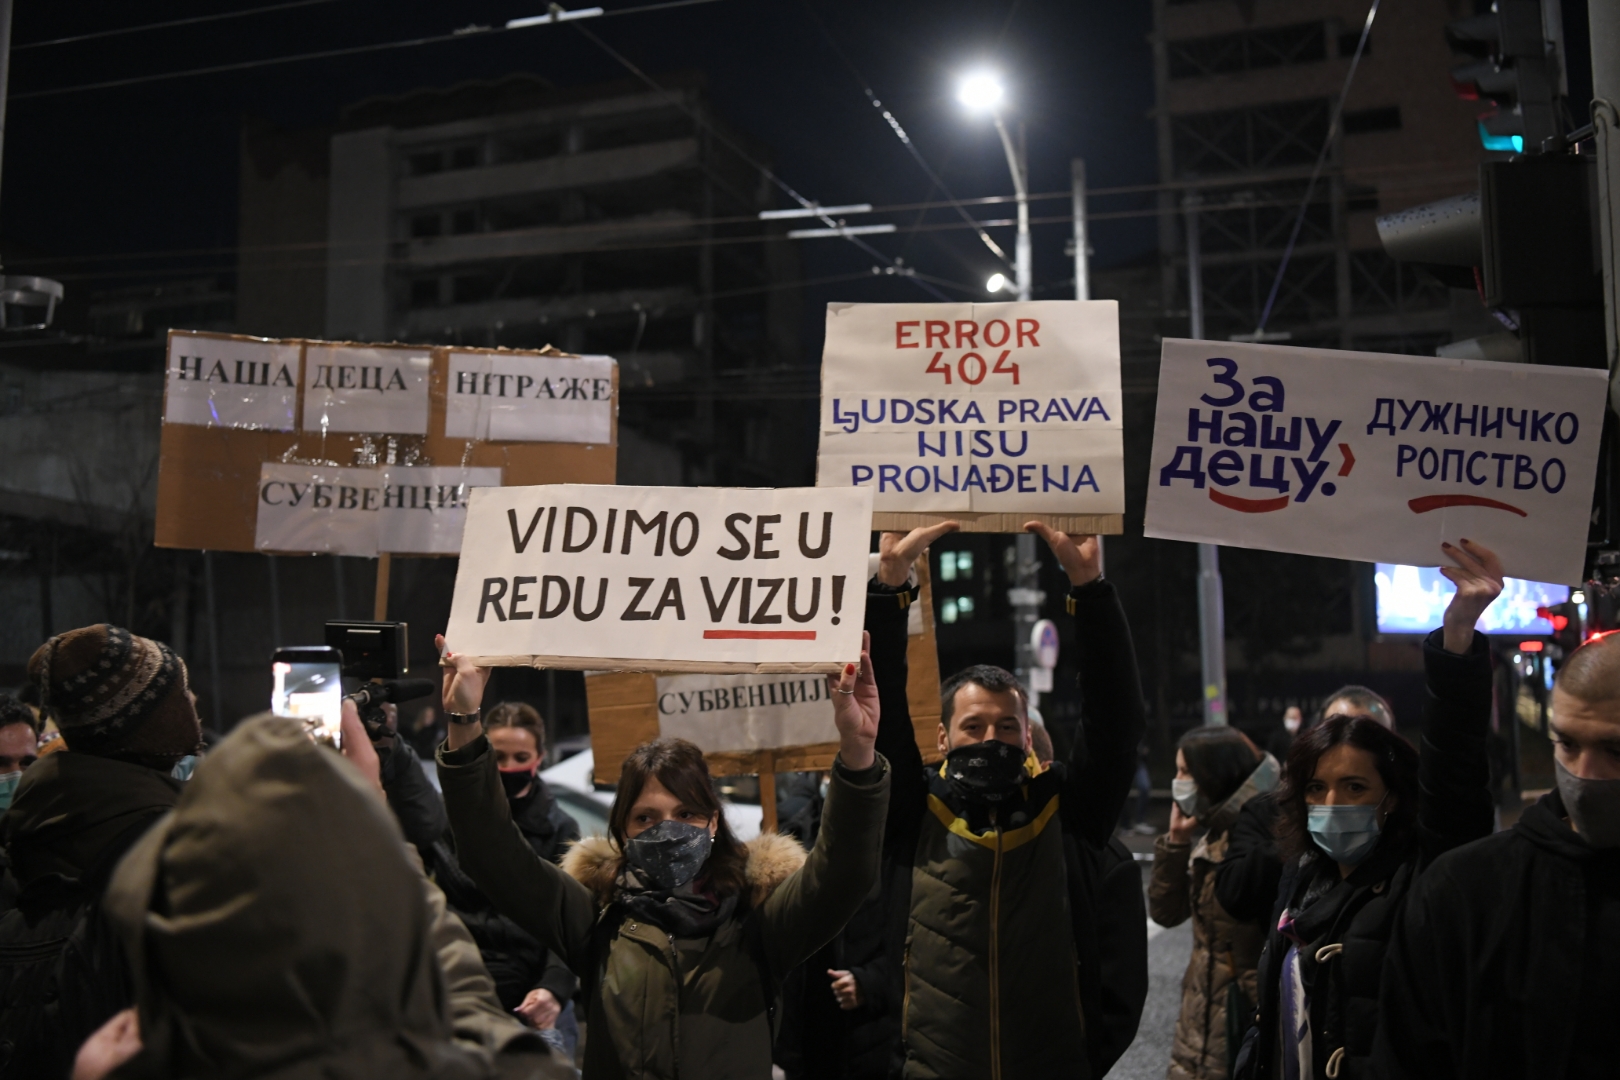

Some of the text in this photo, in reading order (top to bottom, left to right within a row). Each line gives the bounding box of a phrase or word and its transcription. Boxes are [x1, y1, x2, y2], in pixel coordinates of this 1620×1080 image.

[896, 318, 1040, 349] ERROR
[179, 356, 295, 387] НАША
[312, 365, 408, 394] ДЕЦА
[925, 350, 1020, 385] 404
[1200, 357, 1285, 412] За
[832, 396, 1111, 434] LJUDSKA PRAVA
[1188, 407, 1342, 462] нашу
[1366, 398, 1580, 445] ДУЖНИЧКО
[918, 430, 1028, 458] NISU
[851, 464, 1100, 493] PRONAĐENA
[1396, 444, 1567, 494] РОПСТВО
[507, 506, 834, 560] VIDIMO SE U
[476, 574, 847, 626] REDU ZA VIZU!
